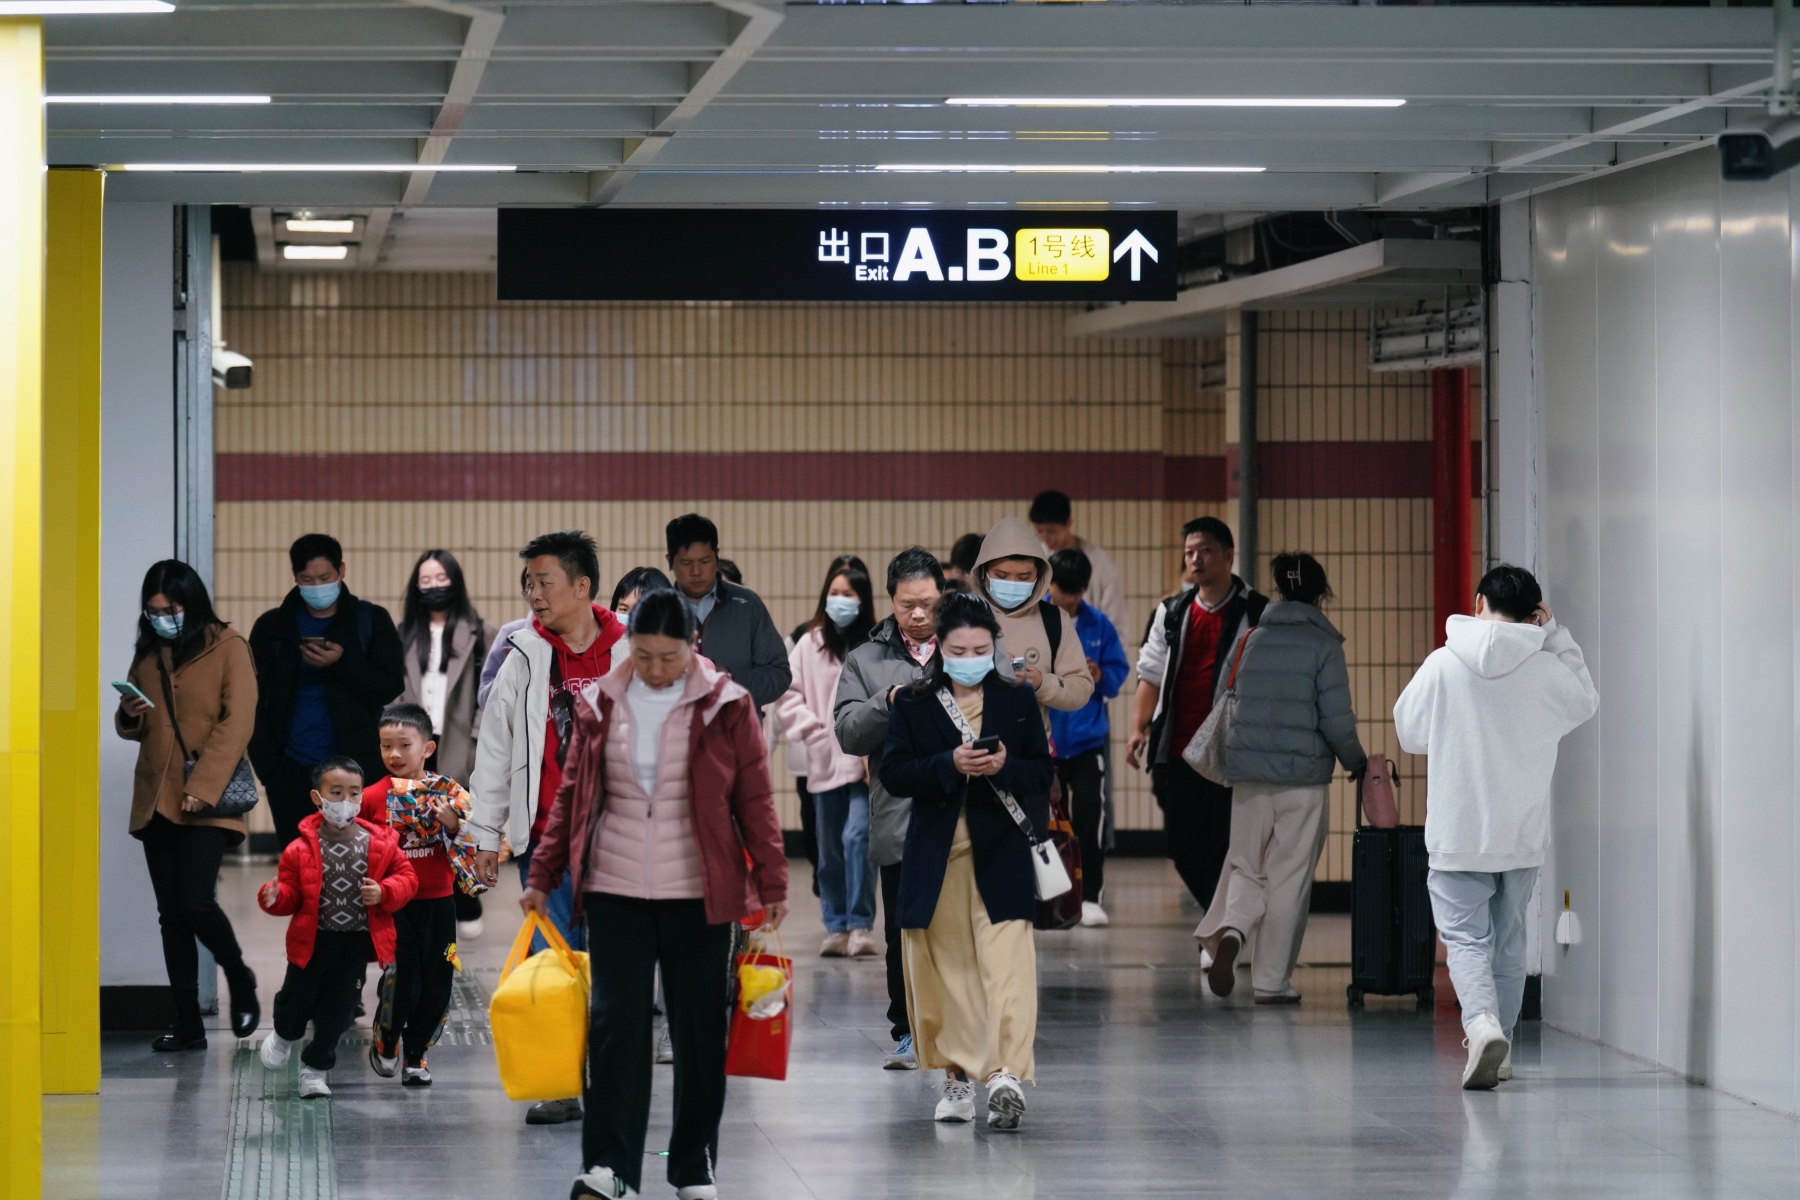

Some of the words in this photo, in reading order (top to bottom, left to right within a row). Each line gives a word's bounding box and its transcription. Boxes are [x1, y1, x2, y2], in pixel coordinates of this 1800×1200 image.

[818, 227, 890, 264] 出口
[892, 227, 1012, 282] A.B
[1028, 234, 1096, 259] 1号线
[855, 264, 889, 281] Exit
[1028, 262, 1058, 275] Line
[1062, 263, 1068, 275] 1
